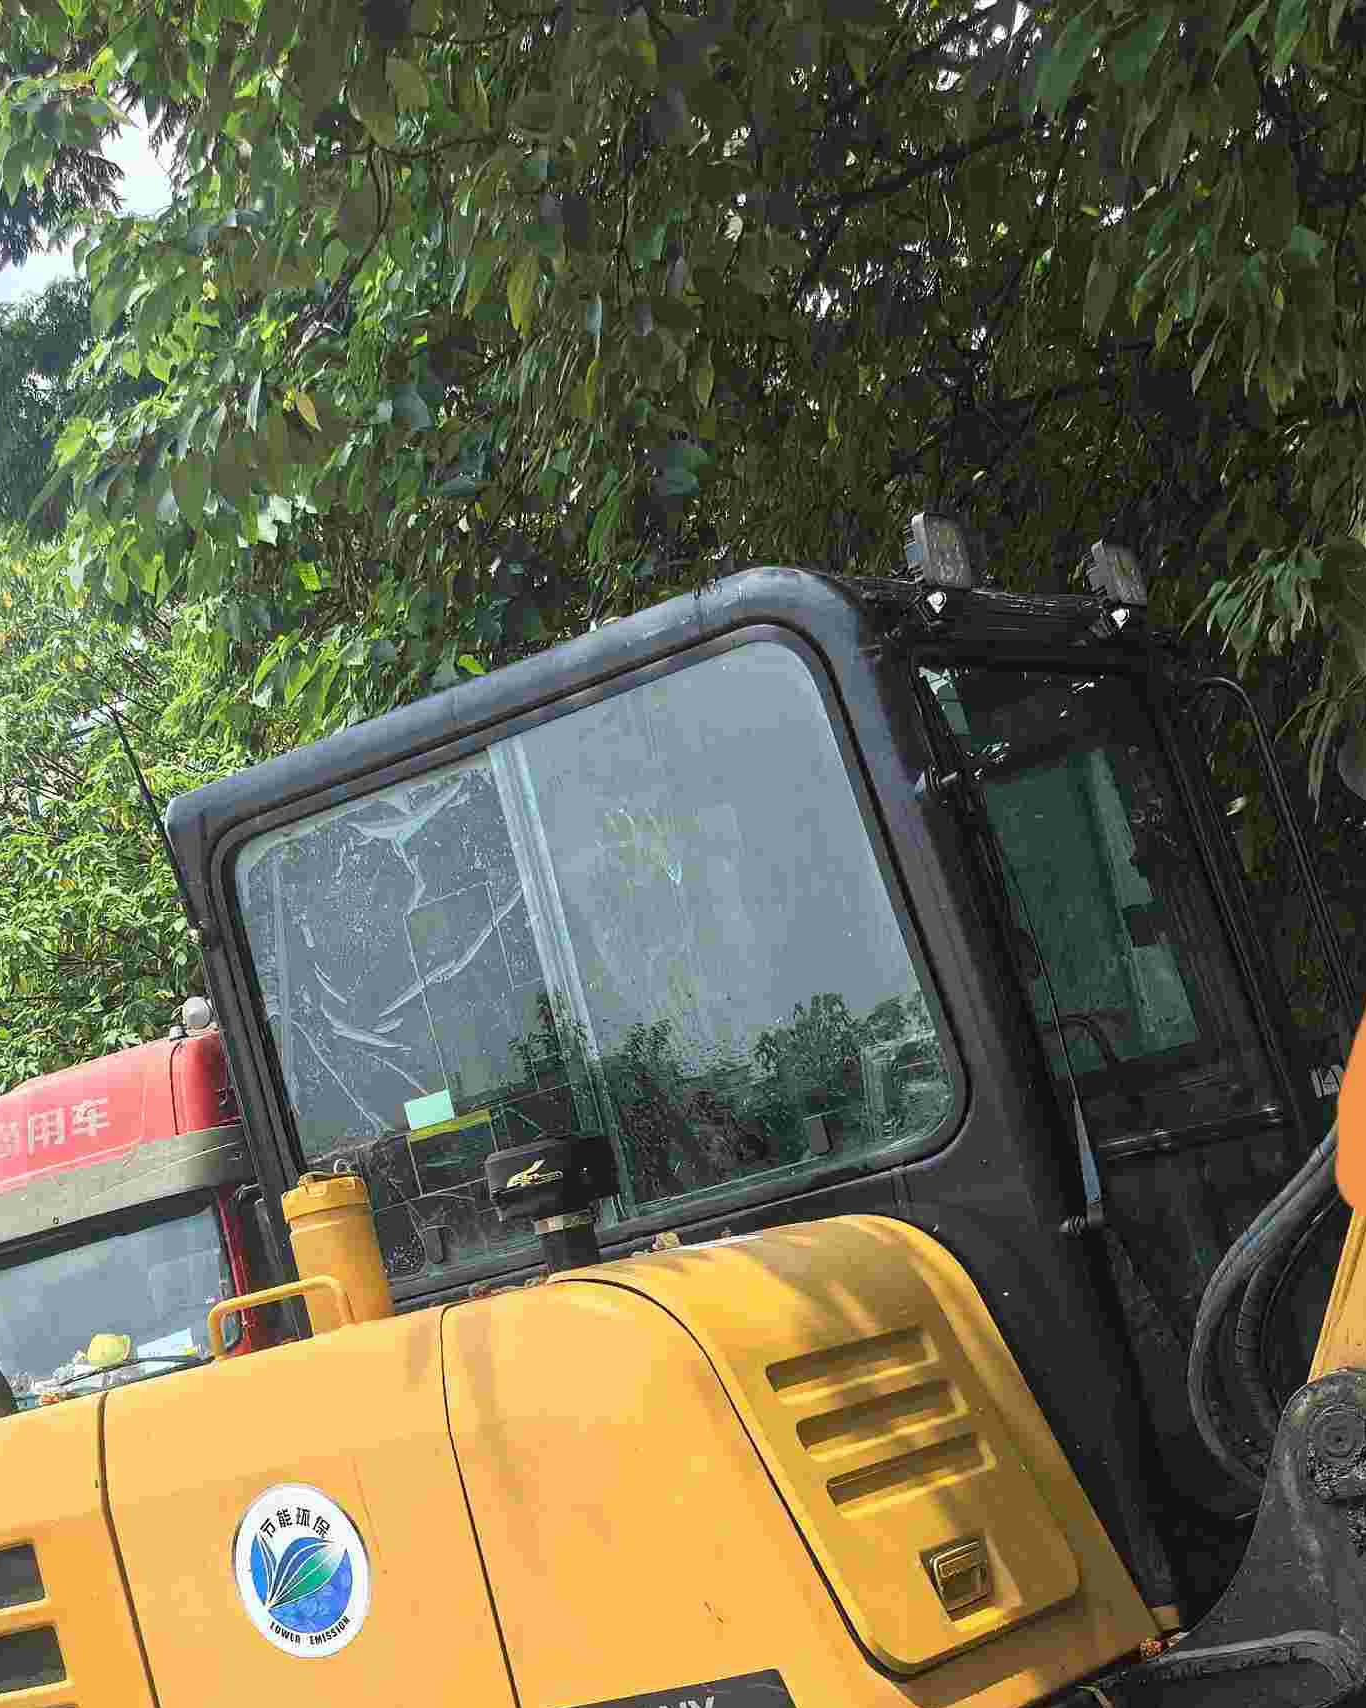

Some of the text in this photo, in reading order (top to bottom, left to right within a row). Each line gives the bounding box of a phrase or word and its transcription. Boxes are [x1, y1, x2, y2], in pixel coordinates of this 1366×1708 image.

[259, 1506, 331, 1538] 节能环保
[269, 1615, 351, 1645] LOWER EMISSION
